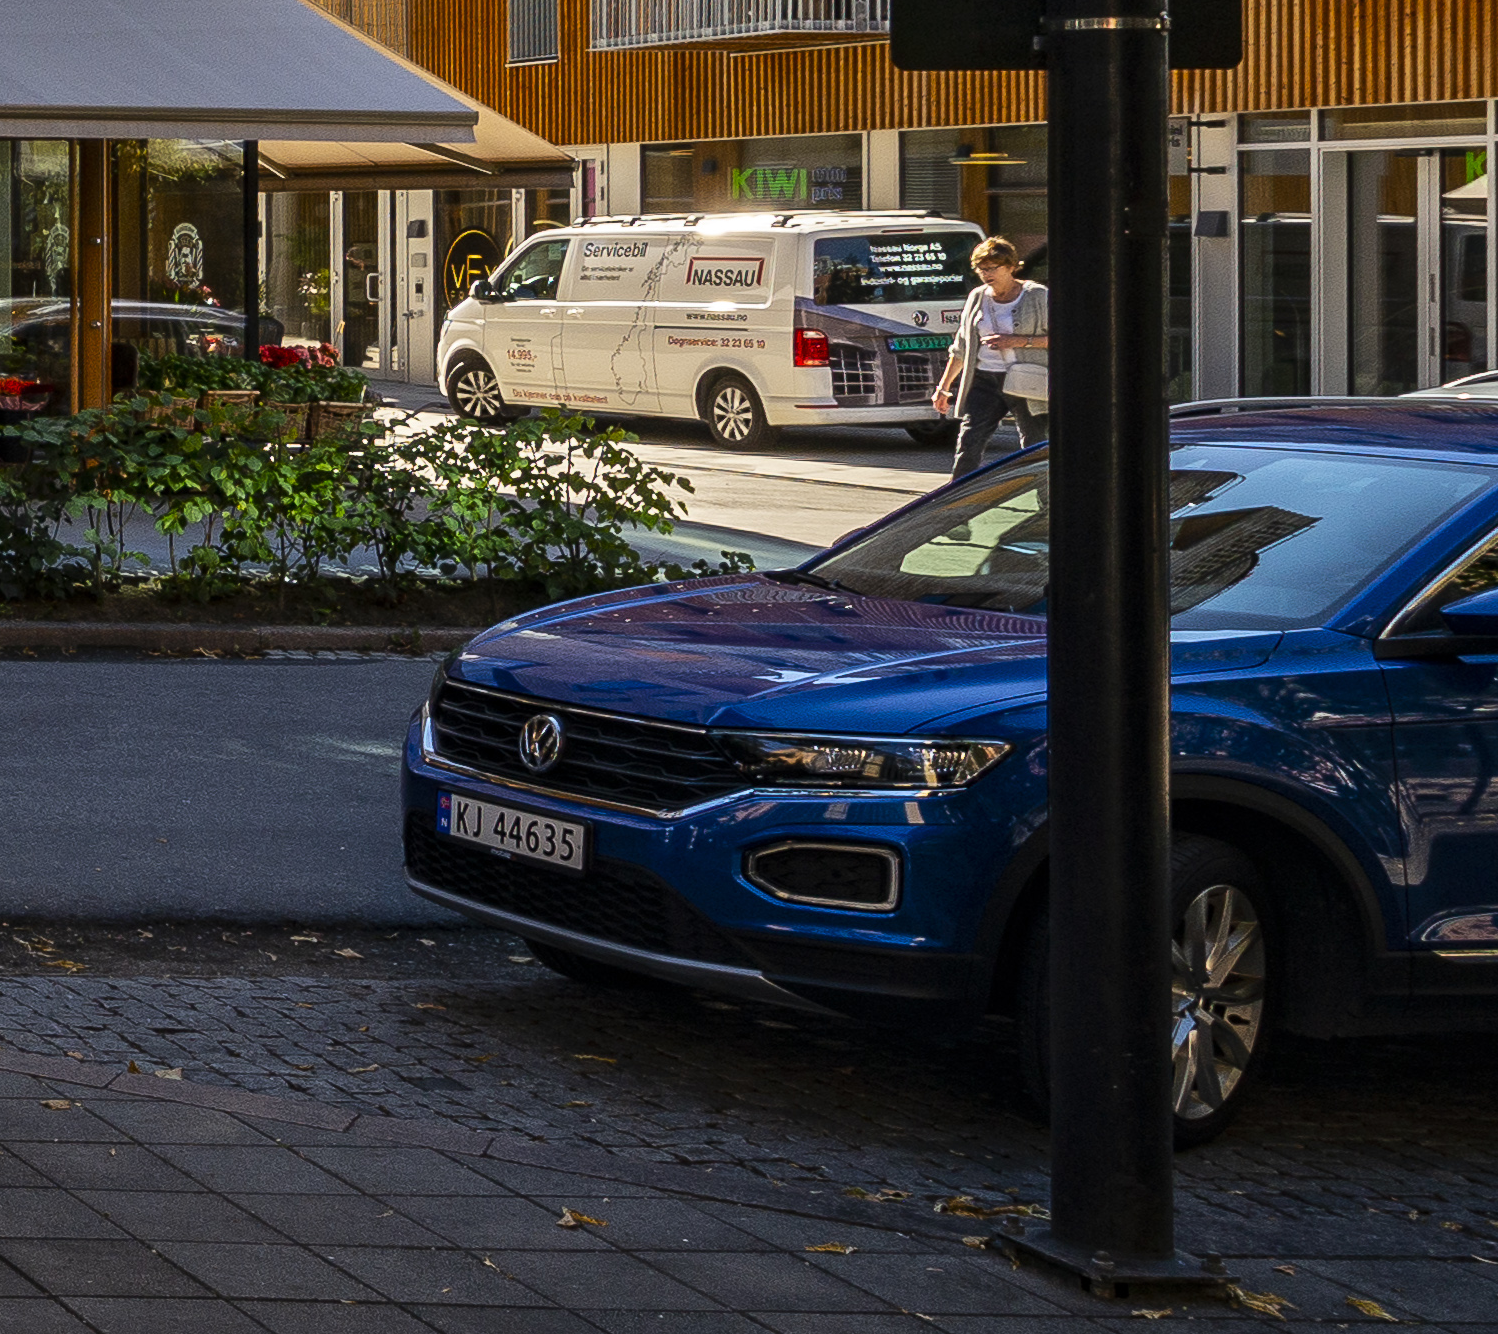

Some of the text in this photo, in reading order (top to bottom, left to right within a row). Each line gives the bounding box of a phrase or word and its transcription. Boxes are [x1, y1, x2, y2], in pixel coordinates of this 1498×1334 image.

[731, 167, 808, 200] KIWI
[583, 241, 649, 259] Servicebil
[691, 268, 757, 287] NASSAU
[720, 337, 731, 348] 32
[731, 337, 742, 348] 23
[456, 800, 575, 862] KJ 44635
